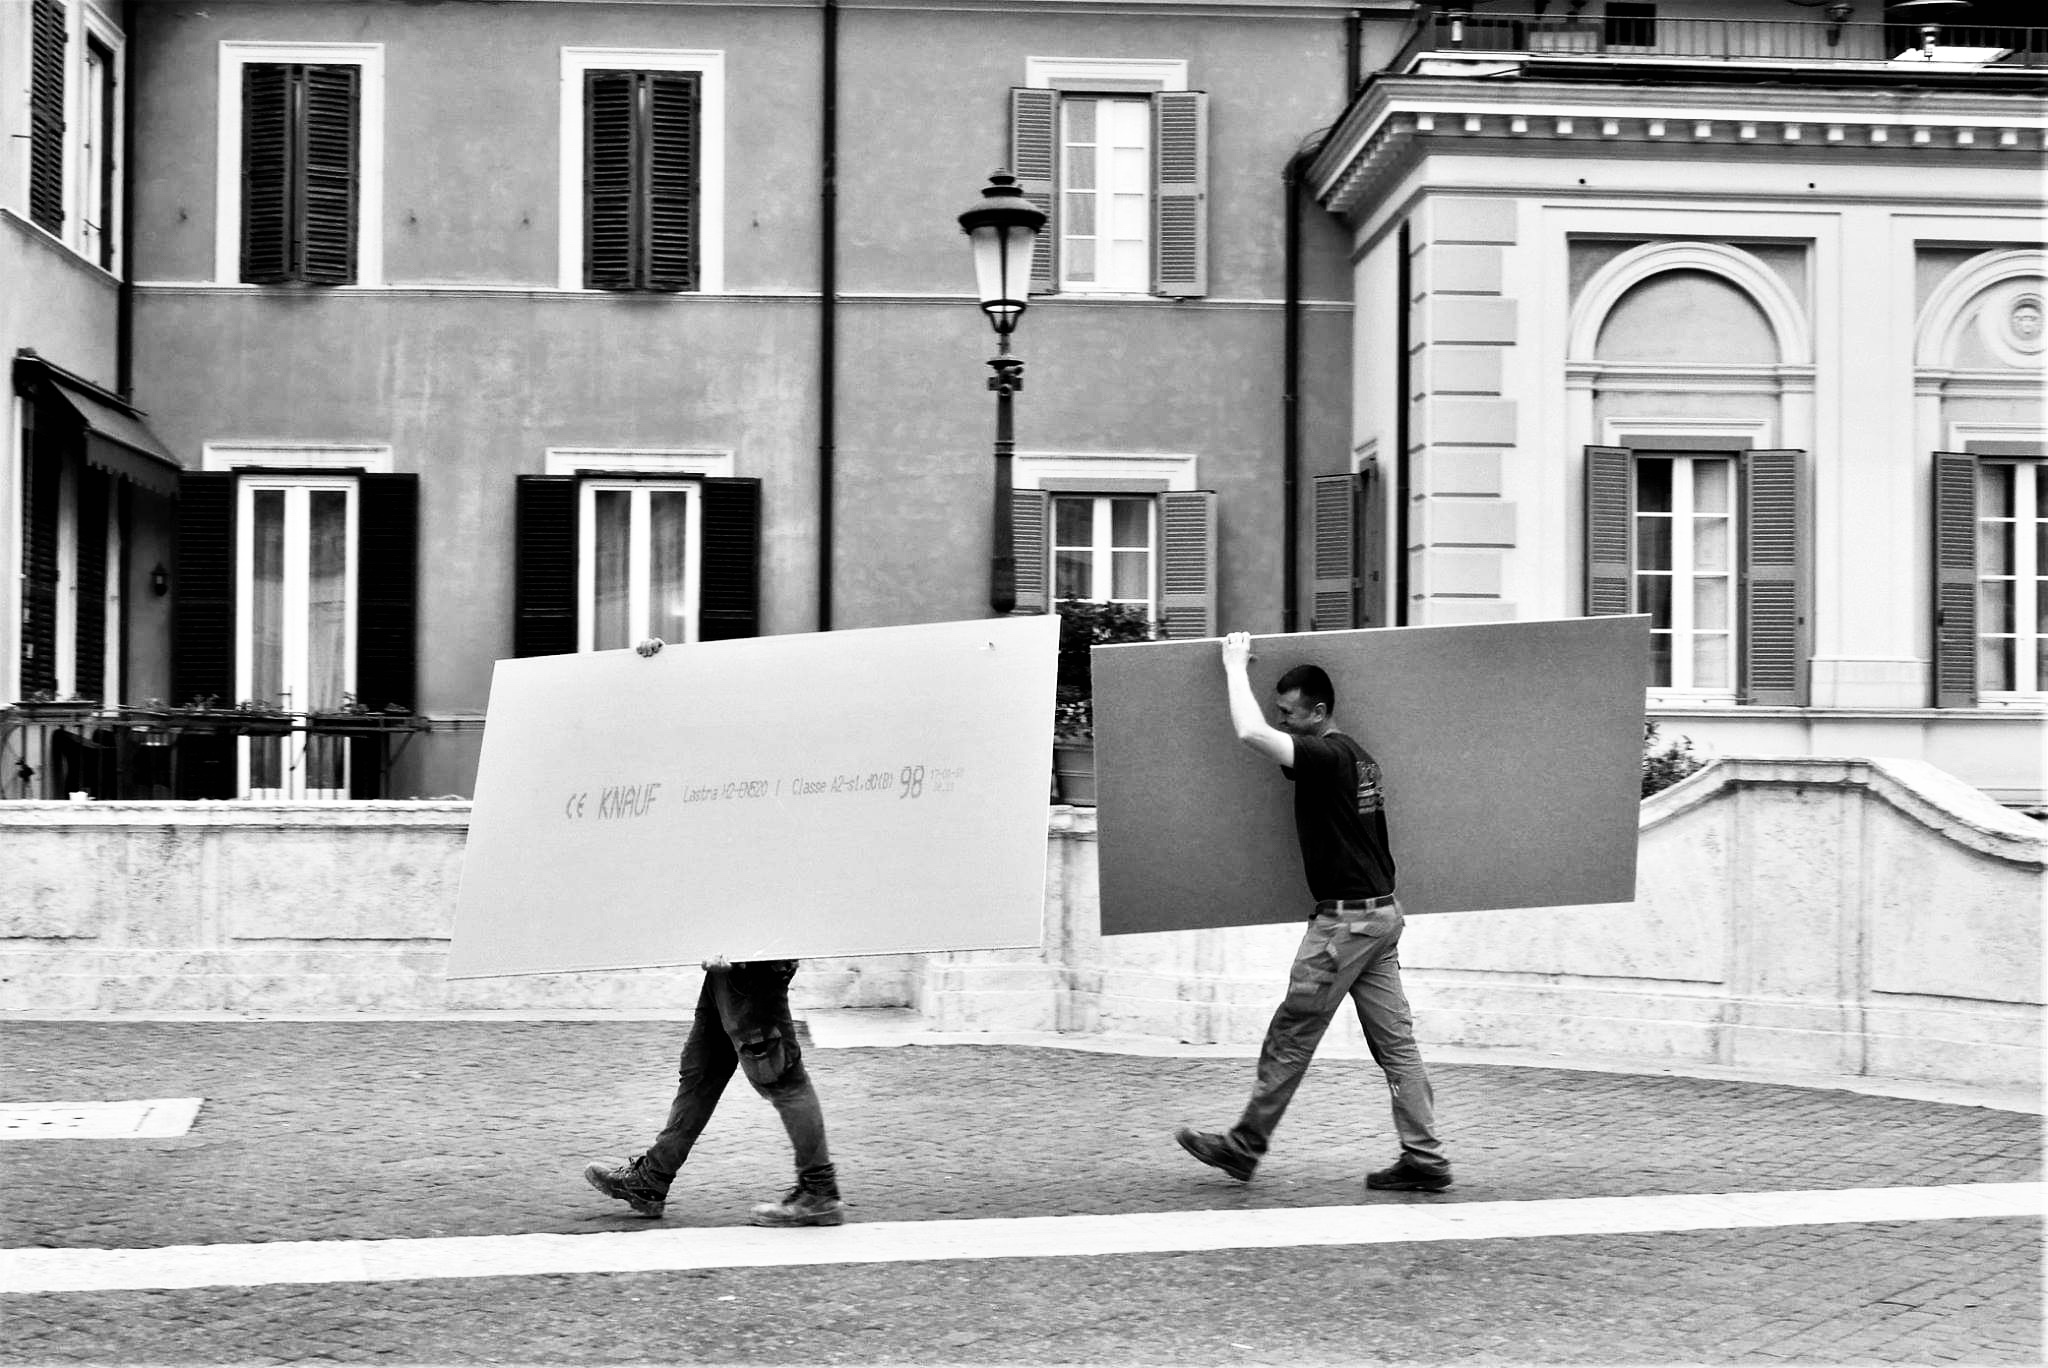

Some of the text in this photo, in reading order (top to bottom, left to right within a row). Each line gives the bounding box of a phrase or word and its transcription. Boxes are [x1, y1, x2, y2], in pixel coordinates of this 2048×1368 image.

[598, 782, 661, 819] KNAUF
[792, 777, 827, 795] Classe
[899, 764, 925, 800] 98
